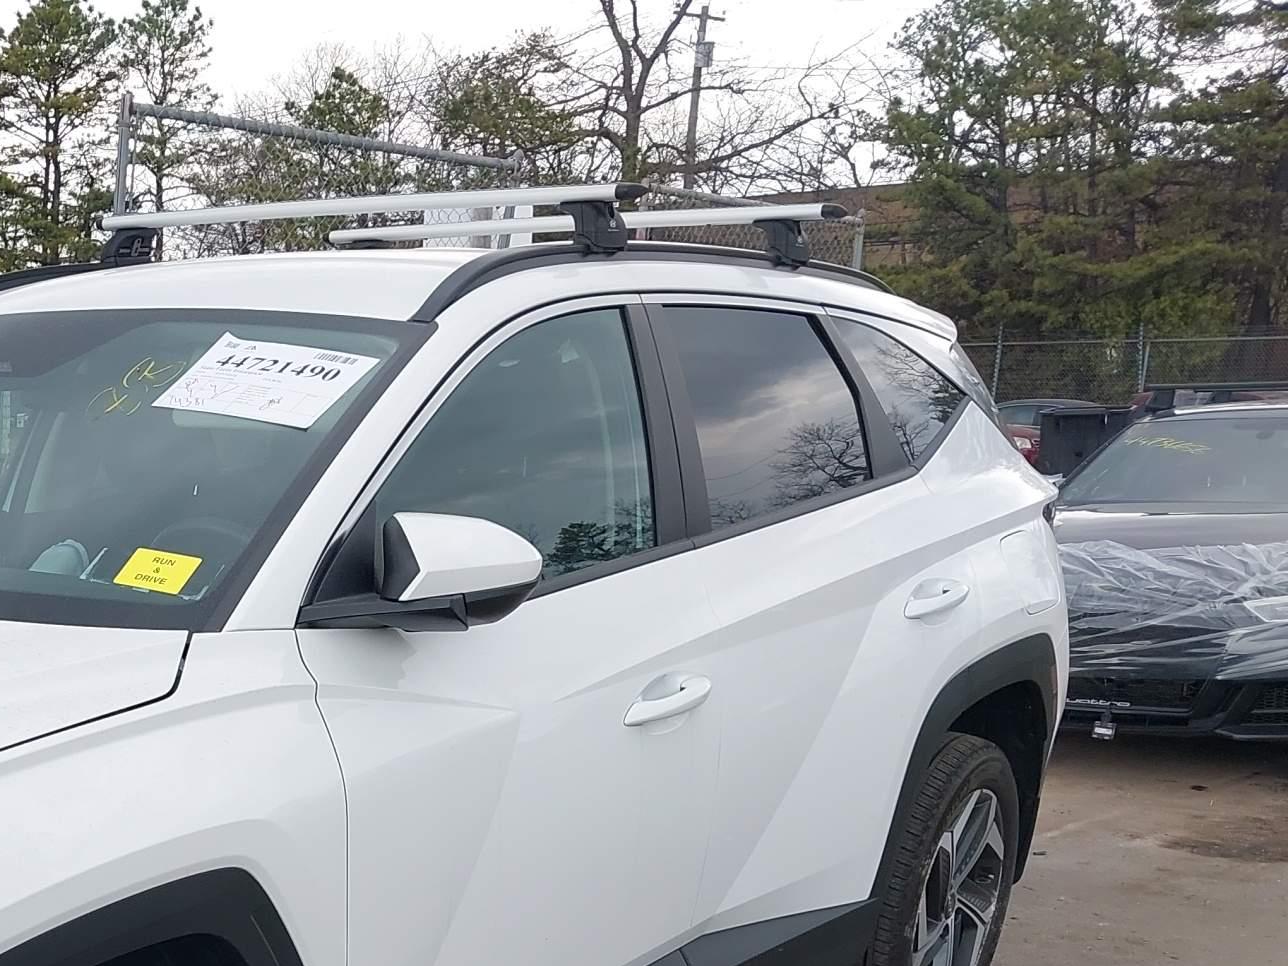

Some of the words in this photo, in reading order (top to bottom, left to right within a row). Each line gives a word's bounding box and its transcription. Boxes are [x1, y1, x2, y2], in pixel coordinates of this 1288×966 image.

[215, 353, 342, 382] 44721490
[151, 556, 176, 566] RUN
[134, 573, 168, 585] DRIVE
[1066, 698, 1131, 707] uattro
